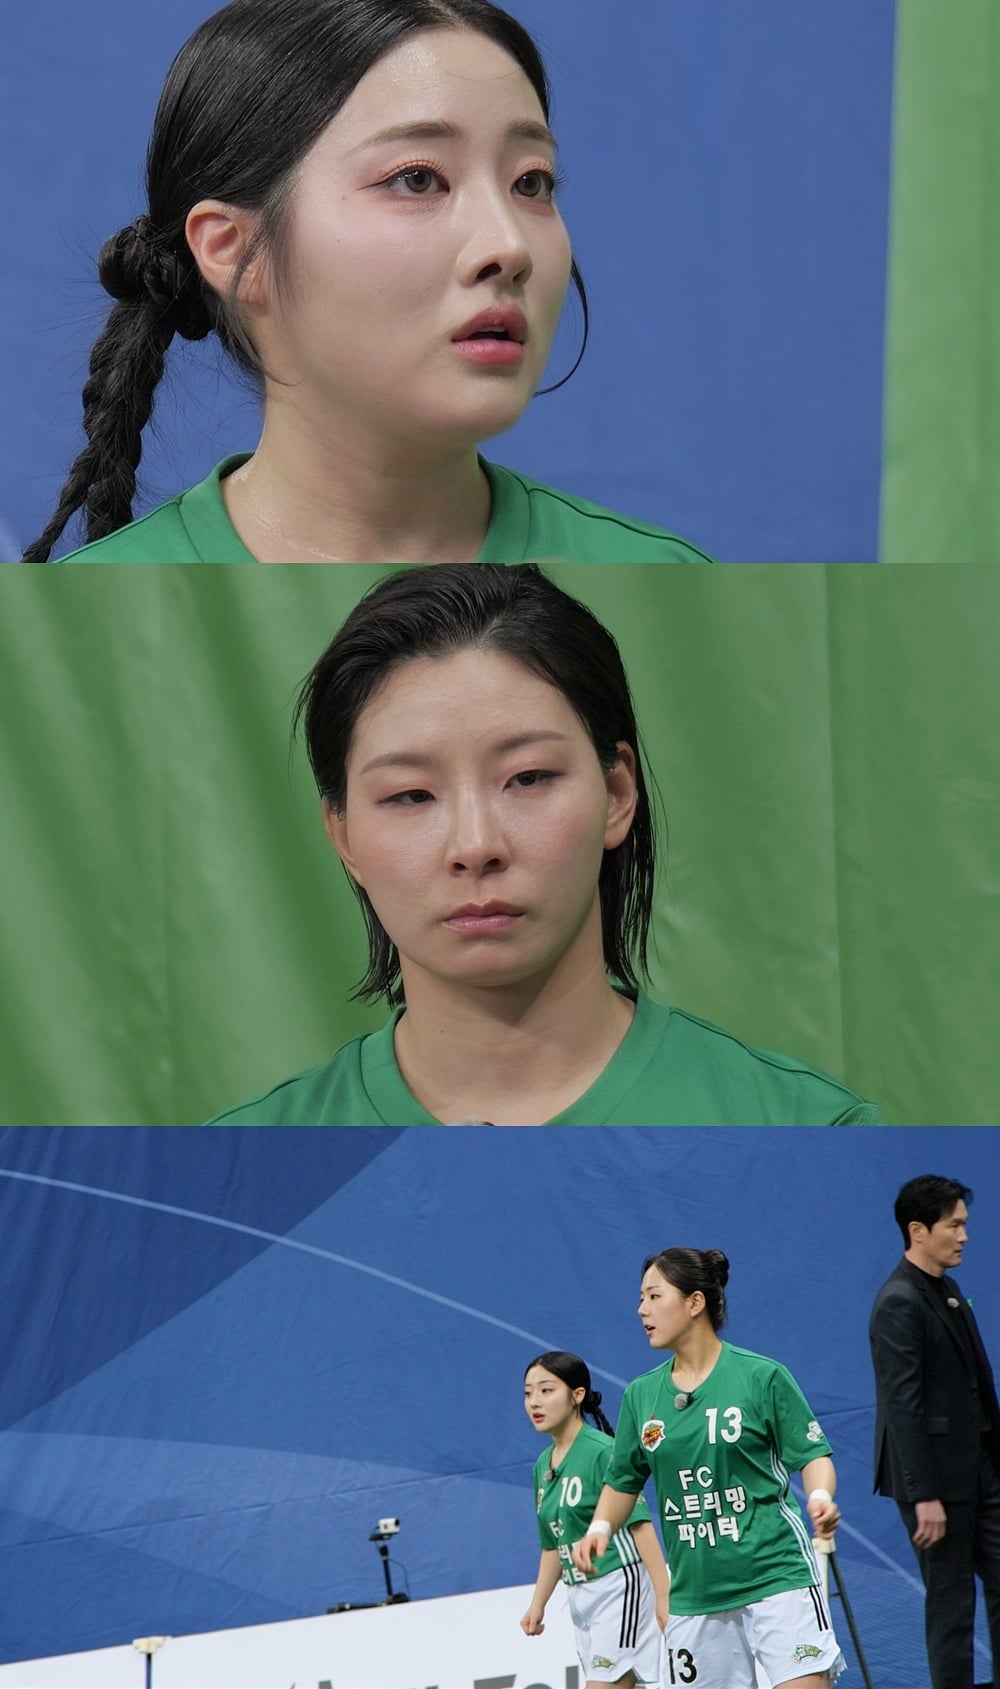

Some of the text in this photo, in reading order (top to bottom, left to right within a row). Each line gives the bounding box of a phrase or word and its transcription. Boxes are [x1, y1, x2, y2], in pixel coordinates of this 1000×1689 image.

[705, 1406, 743, 1445] 13
[560, 1475, 583, 1508] 10
[678, 1465, 714, 1491] FC
[664, 1486, 746, 1521] 스트리밍
[677, 1516, 740, 1549] 파이터
[668, 1648, 698, 1685] 13
